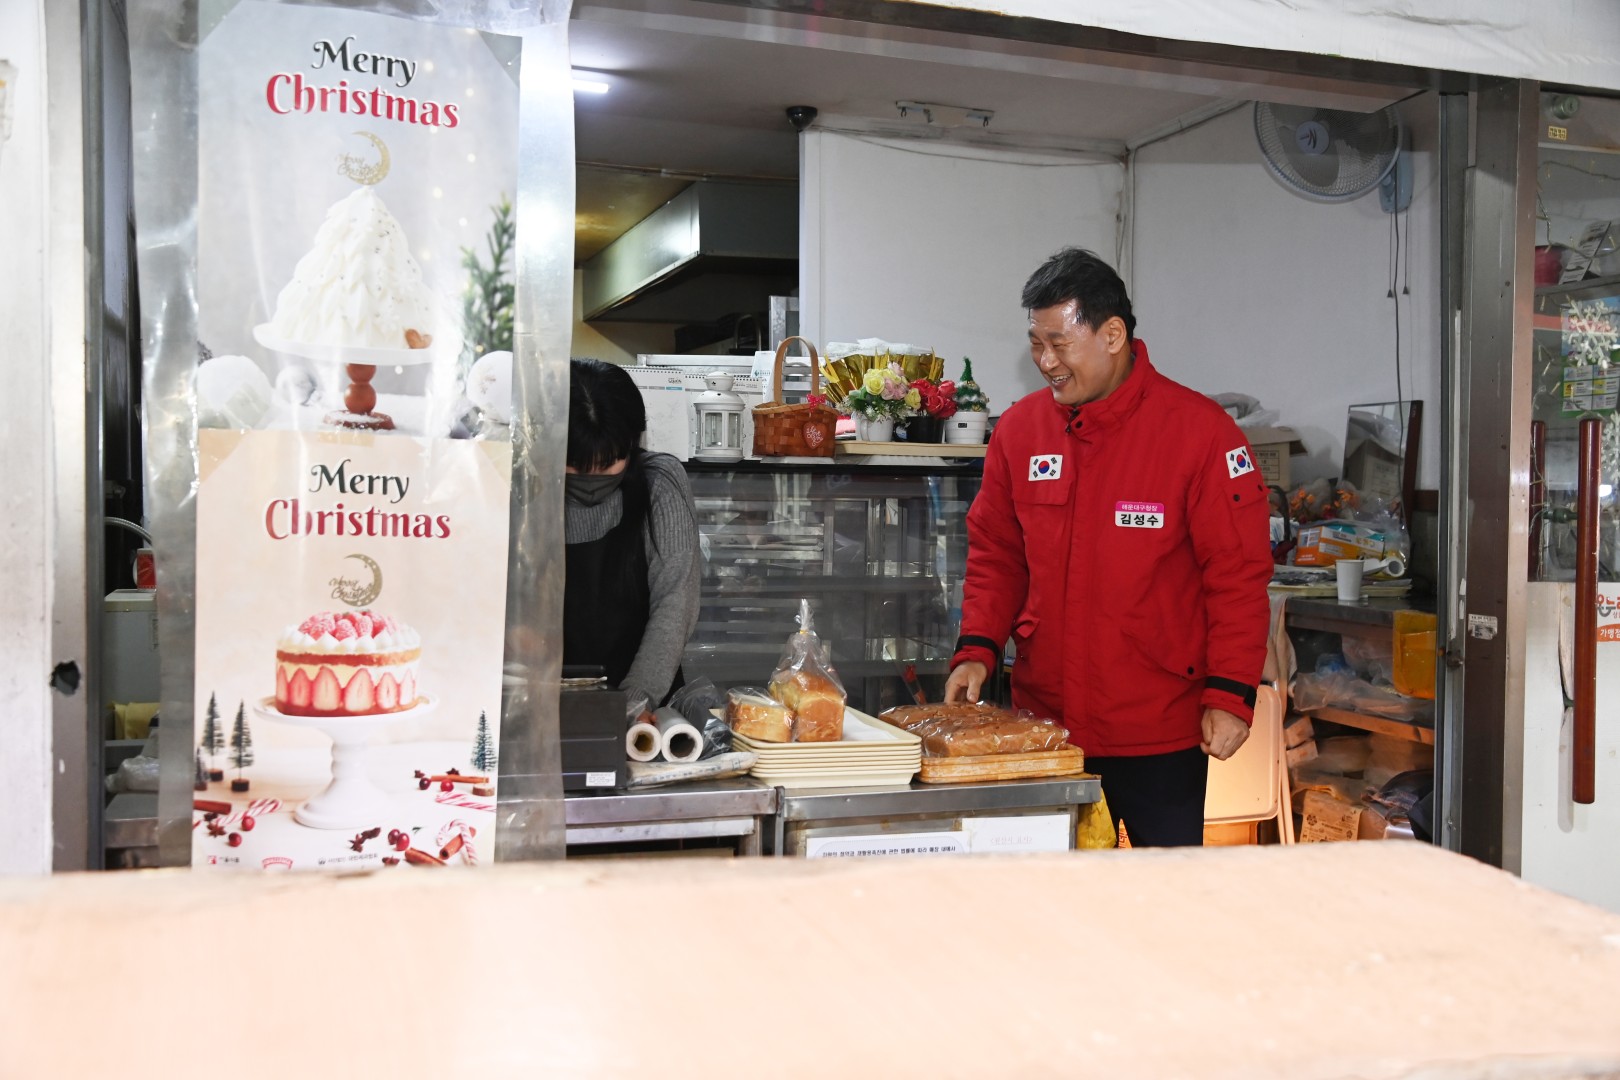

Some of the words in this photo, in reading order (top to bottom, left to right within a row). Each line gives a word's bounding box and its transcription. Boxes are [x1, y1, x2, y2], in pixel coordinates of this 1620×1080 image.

[311, 36, 417, 88] Merry
[266, 72, 460, 128] Christmas
[308, 459, 410, 504] Merry
[265, 498, 451, 540] Christmas
[1120, 513, 1159, 526] 김성수
[1121, 503, 1158, 512] 해운대구청장
